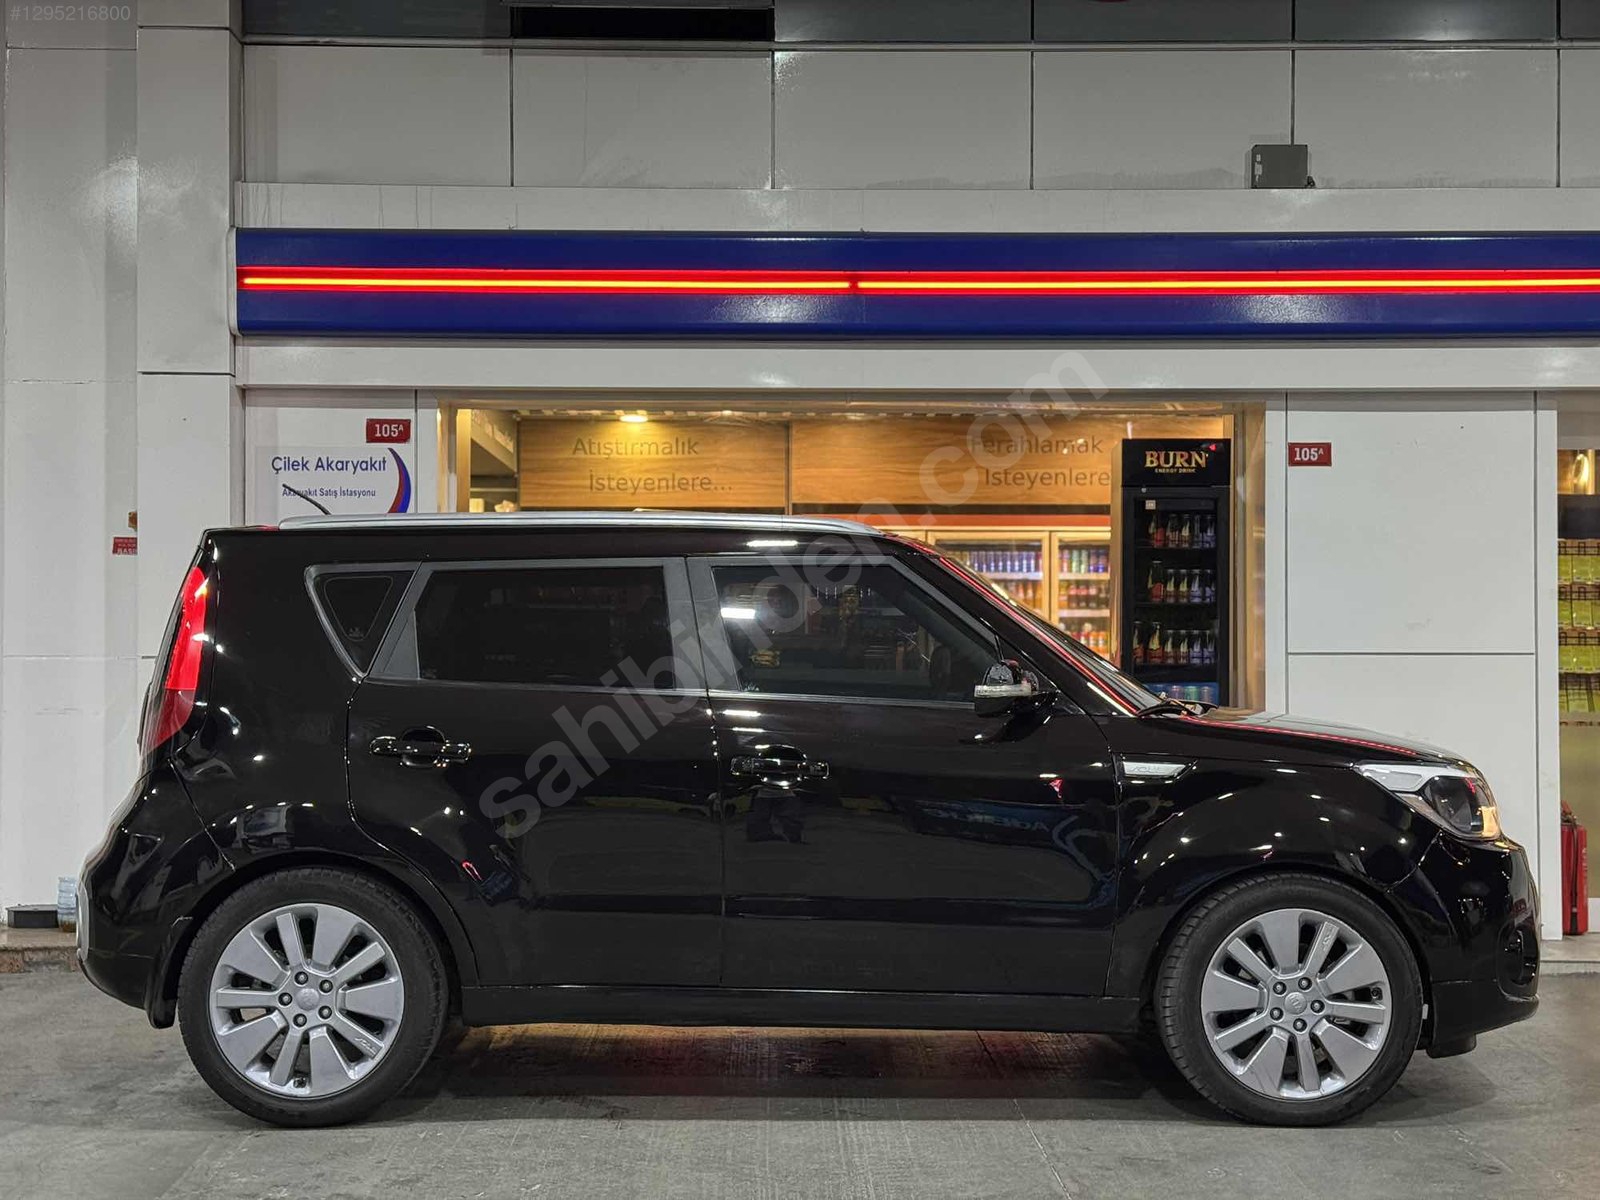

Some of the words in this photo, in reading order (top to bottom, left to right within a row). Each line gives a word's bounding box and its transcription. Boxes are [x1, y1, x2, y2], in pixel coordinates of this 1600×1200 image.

[271, 456, 310, 474] Çilek
[314, 456, 387, 475] Akaryakıt
[1144, 450, 1206, 468] BURN
[319, 488, 338, 498] Satış
[339, 486, 376, 498] İstasyonu
